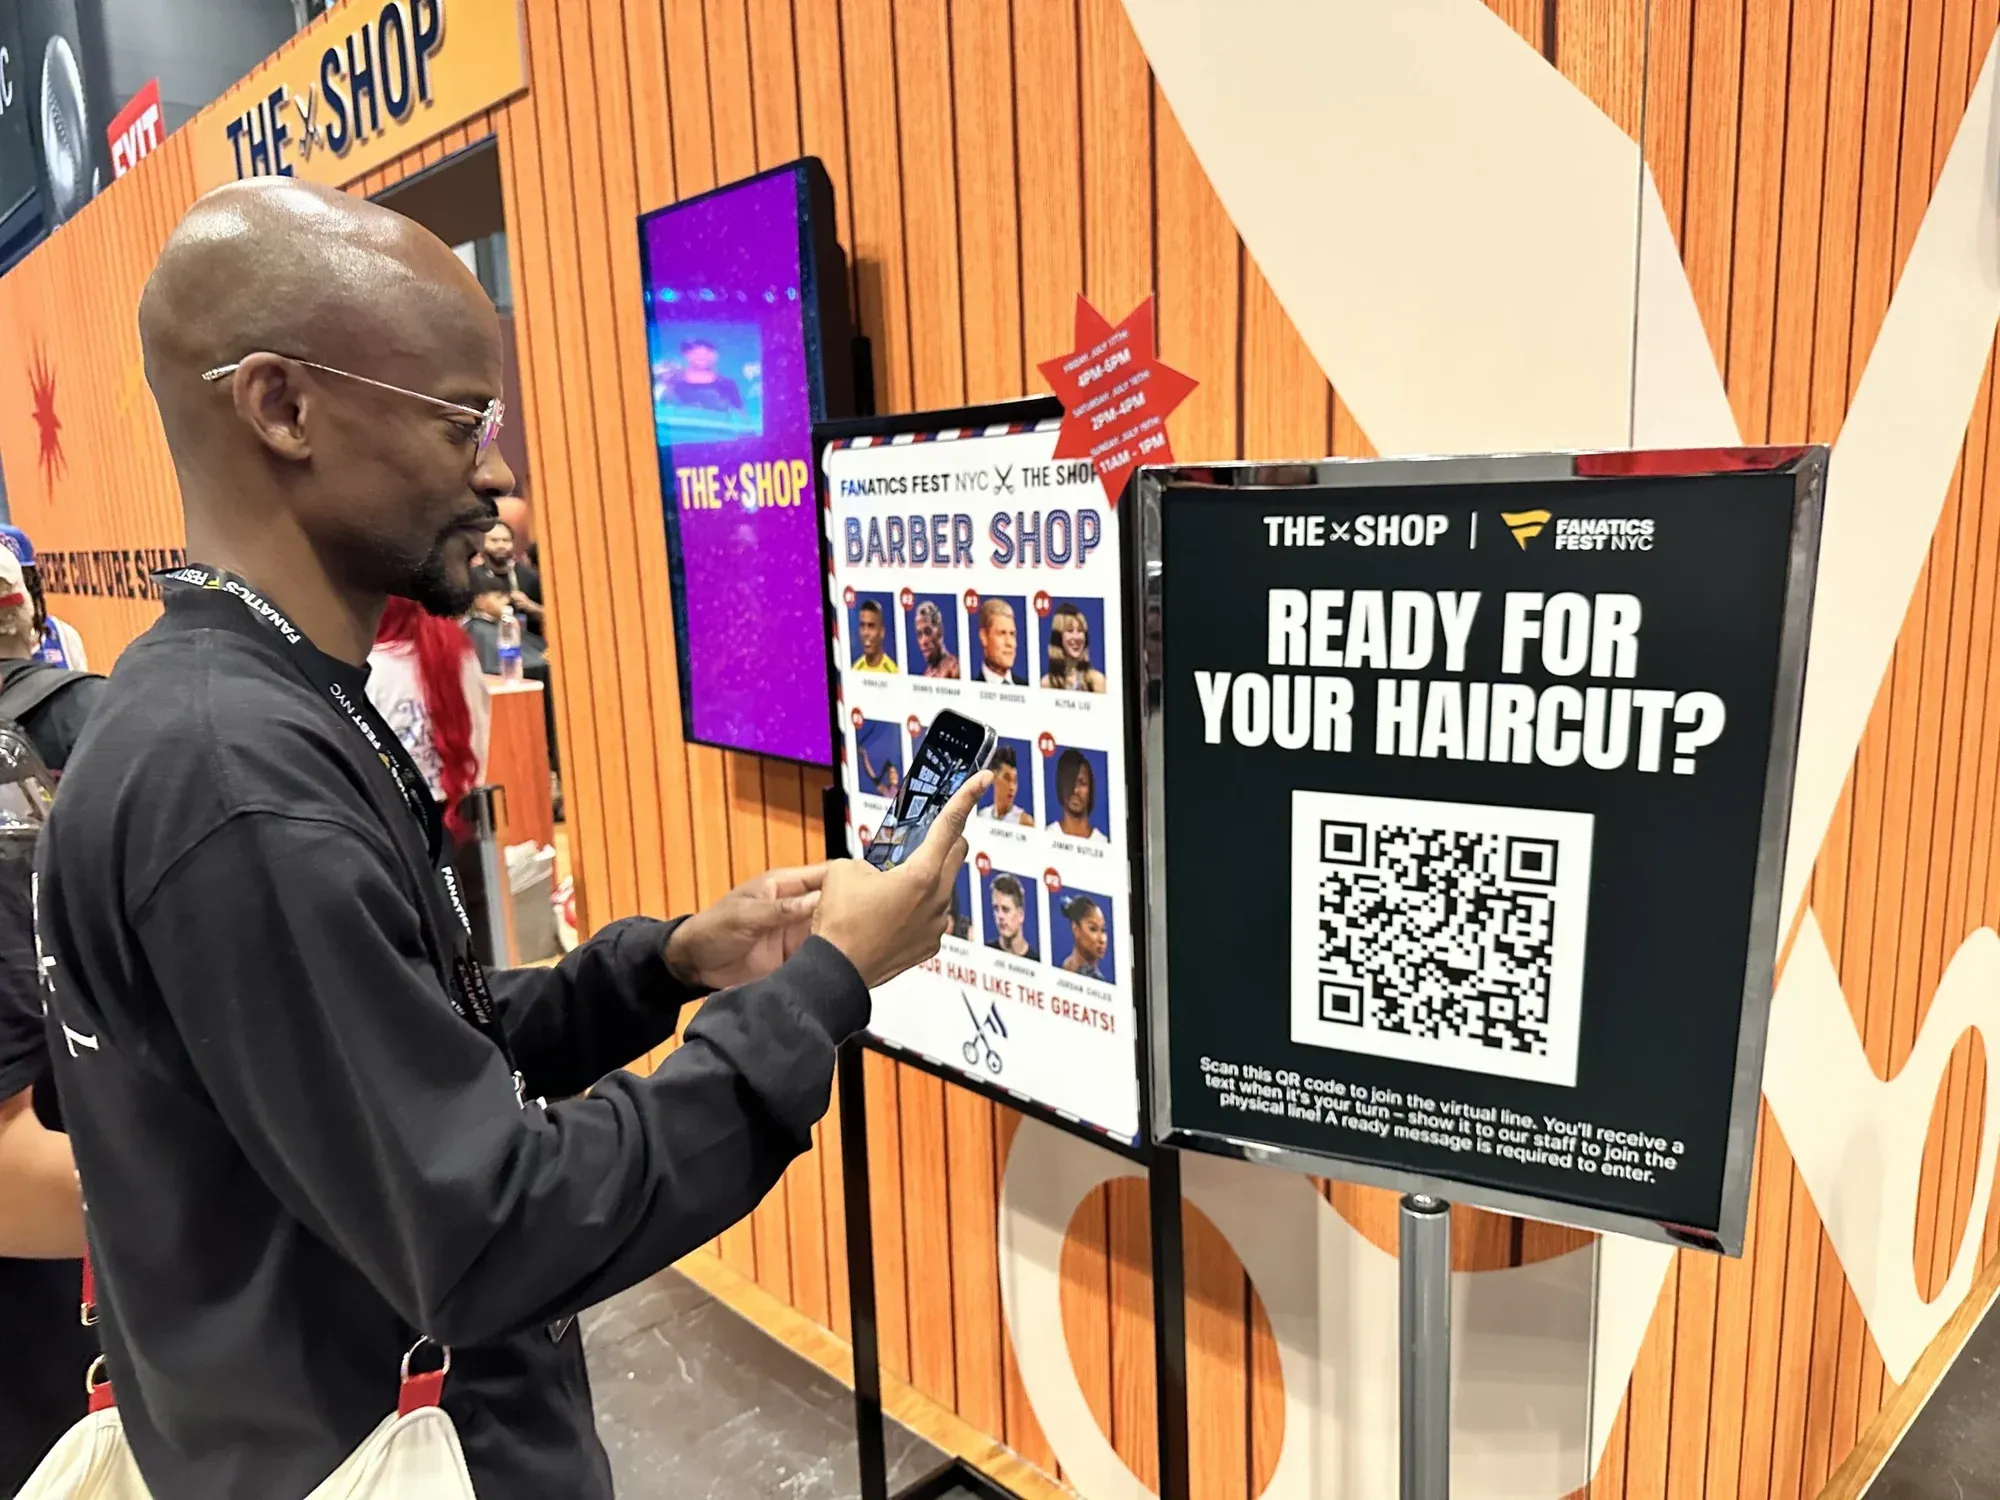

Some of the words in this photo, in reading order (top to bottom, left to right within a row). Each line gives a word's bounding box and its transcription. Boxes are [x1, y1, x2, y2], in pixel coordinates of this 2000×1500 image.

[226, 84, 296, 179] THE
[320, 0, 445, 156] SHOP
[1100, 449, 1131, 474] 11AM
[1139, 432, 1165, 455] 1PM
[677, 466, 722, 510] THE
[739, 459, 809, 511] SHOP
[840, 476, 908, 498] FANATICS
[912, 474, 951, 493] FEST
[955, 471, 989, 492] NYC
[1022, 466, 1050, 488] THE
[844, 513, 974, 568] BARBER
[990, 509, 1101, 569] SHOP
[1263, 515, 1326, 547] THE
[1353, 514, 1449, 547] SHOP
[1555, 518, 1655, 537] FANATICS
[1555, 534, 1605, 551] FEST
[1610, 534, 1654, 552] NYC
[69, 549, 136, 599] CULTURE
[223, 581, 301, 645] FANATICS
[1267, 588, 1482, 672] READY
[1501, 591, 1643, 679] FOR
[329, 683, 355, 714] NYC
[1194, 670, 1354, 753] YOUR
[1375, 678, 1727, 775] HAIRCUT?
[352, 714, 382, 750] FEST
[946, 961, 978, 987] HAIR
[982, 973, 1013, 999] LIKE
[1017, 984, 1045, 1010] THE
[1051, 996, 1116, 1034] GREATS!
[1200, 1056, 1240, 1076] Scan
[1242, 1064, 1273, 1083] this
[1275, 1069, 1301, 1087] QR
[1303, 1076, 1347, 1096] code
[1350, 1083, 1368, 1100] to
[1371, 1085, 1403, 1106] join
[1406, 1093, 1436, 1112] the
[1439, 1099, 1498, 1122] virtual
[1500, 1108, 1539, 1130] line.
[1543, 1115, 1593, 1140] You'll
[1596, 1127, 1668, 1151] receive
[1671, 1140, 1685, 1155] a
[1205, 1073, 1236, 1091] text
[1239, 1079, 1284, 1100] when
[1286, 1086, 1310, 1106] it's
[1314, 1093, 1351, 1114] your
[1355, 1101, 1390, 1119] turn
[1408, 1109, 1457, 1131] show
[1458, 1117, 1471, 1134] it
[1475, 1121, 1495, 1139] to
[1498, 1127, 1530, 1144] our
[1533, 1131, 1577, 1153] staff
[1581, 1140, 1601, 1157] to
[1604, 1143, 1640, 1164] join
[1644, 1149, 1678, 1171] the
[1219, 1091, 1284, 1116] physical
[1287, 1102, 1322, 1123] line!
[1324, 1110, 1339, 1126] A
[1341, 1115, 1391, 1138] ready
[1393, 1123, 1474, 1152] message
[1476, 1136, 1492, 1154] is
[1496, 1142, 1573, 1169] required
[1577, 1155, 1597, 1173] to
[1600, 1162, 1657, 1184] enter.
